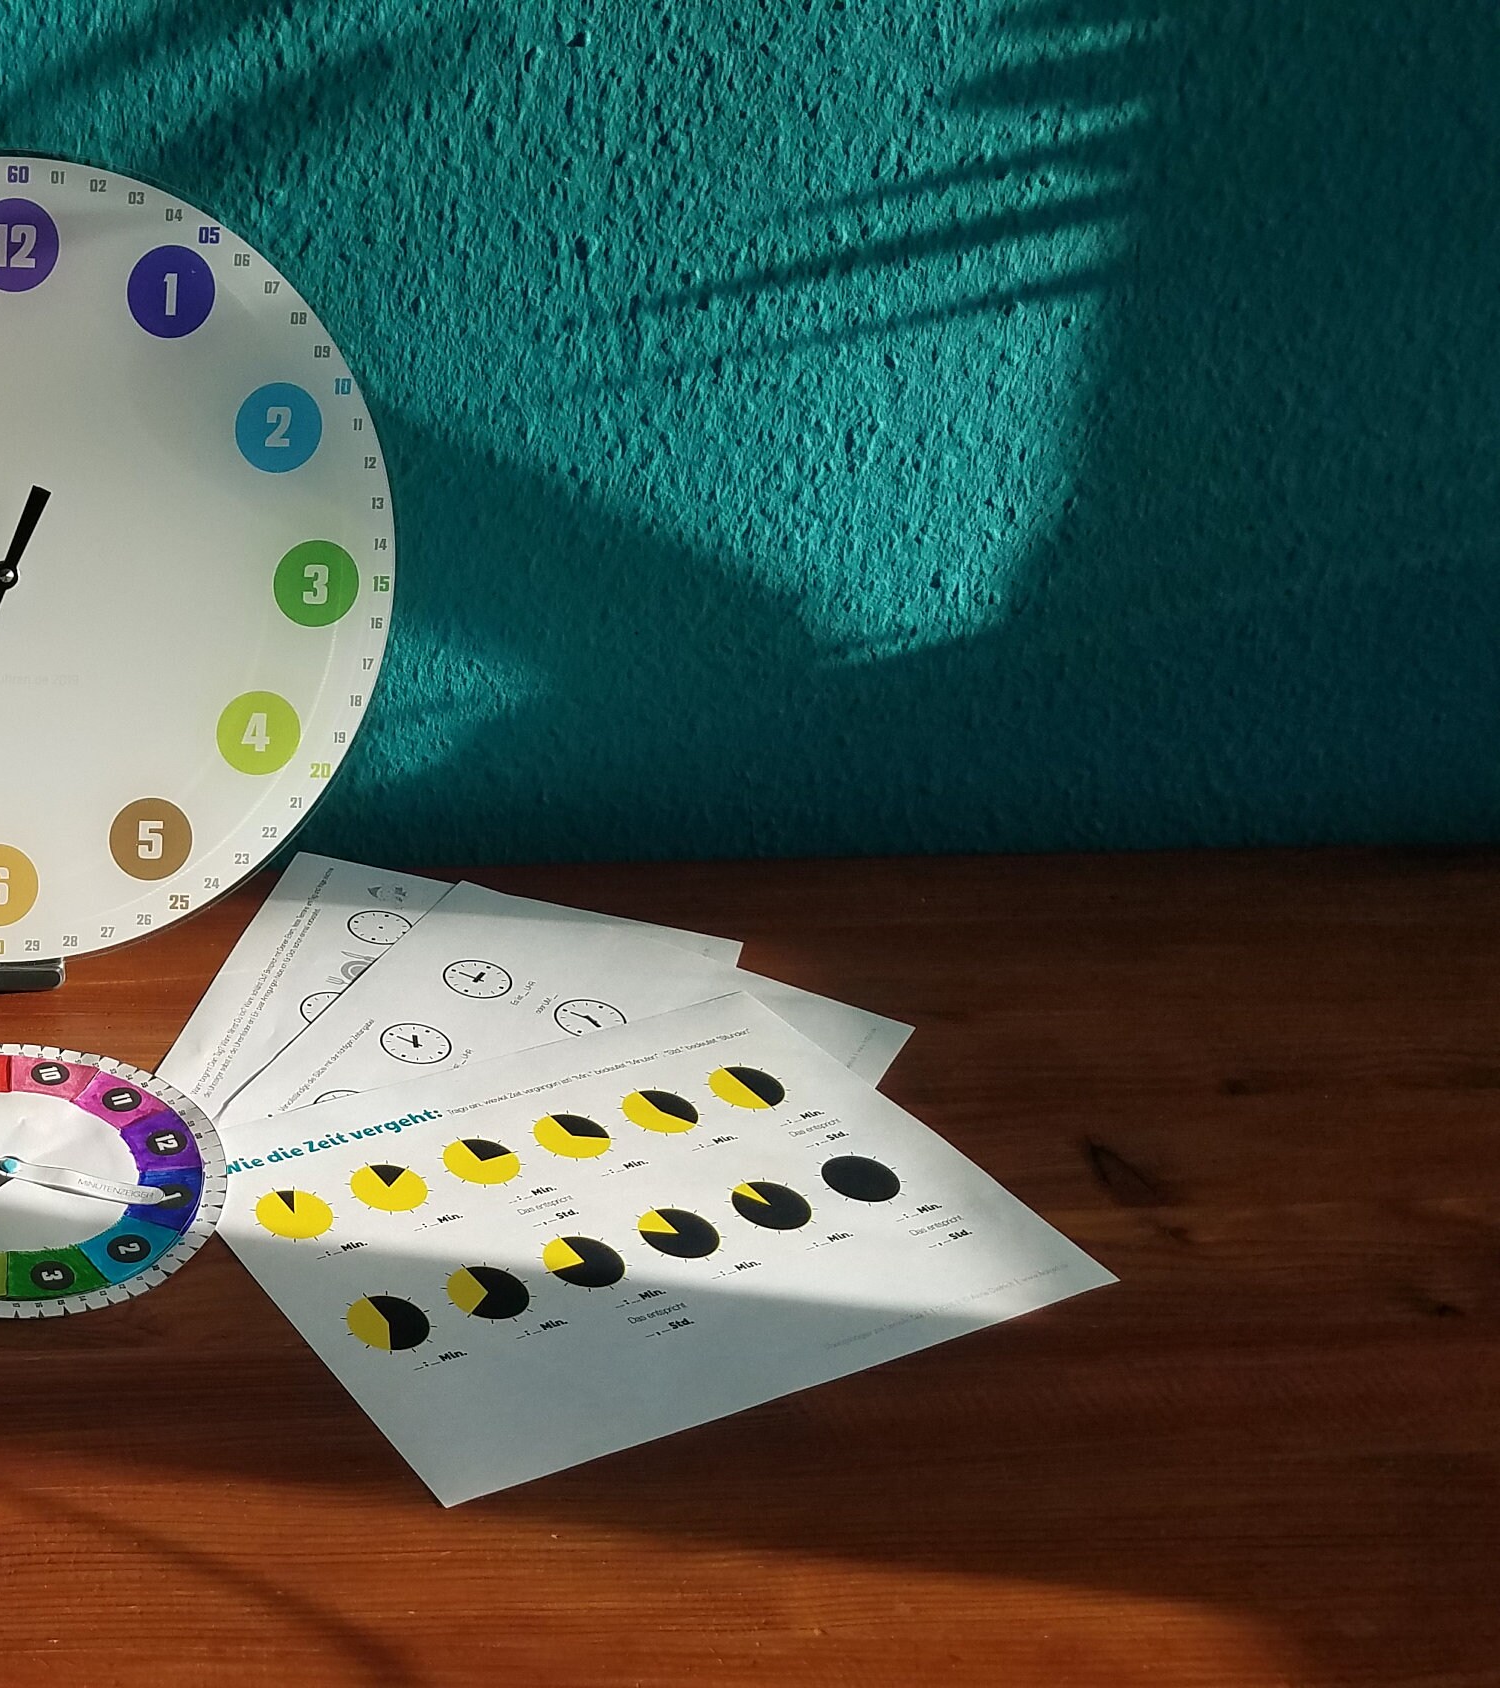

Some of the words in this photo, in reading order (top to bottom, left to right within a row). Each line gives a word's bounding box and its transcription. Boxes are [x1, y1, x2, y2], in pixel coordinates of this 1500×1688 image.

[7, 166, 29, 183] 60
[51, 171, 64, 184] 01
[90, 179, 107, 192] 02
[129, 192, 144, 205] 03
[166, 209, 182, 221] 04
[199, 227, 220, 244] 05
[234, 253, 250, 266] 06
[265, 281, 280, 294] 07
[163, 273, 178, 316] 1
[291, 312, 307, 325] 08
[314, 346, 330, 358] 09
[335, 379, 351, 394] 10
[265, 407, 291, 447] 2
[354, 419, 362, 431] 11
[364, 457, 376, 469] 12
[372, 497, 384, 509] 13
[374, 538, 387, 550] 14
[302, 565, 329, 605] 3
[373, 576, 389, 592] 15
[371, 617, 382, 629] 16
[362, 658, 373, 670] 17
[349, 695, 362, 707] 18
[241, 713, 269, 751] 4
[334, 732, 346, 743] 19
[310, 763, 330, 779] 20
[290, 797, 302, 808] 21
[262, 826, 277, 838] 22
[137, 821, 164, 859] 5
[234, 853, 249, 865] 23
[204, 877, 219, 889] 24
[169, 895, 189, 909] 25
[137, 914, 152, 925] 26
[100, 926, 115, 938] 27
[25, 940, 40, 951] 29
[63, 935, 78, 947] 28
[39, 1066, 61, 1081] 10
[112, 1093, 132, 1106] 11
[155, 1134, 176, 1150] 12
[267, 1147, 304, 1163] die
[303, 1132, 349, 1152] Zeit
[349, 1109, 443, 1140] vergeht:
[78, 1178, 155, 1199] MINUTENZEIGER
[119, 1243, 139, 1255] 2
[41, 1270, 62, 1281] 3
